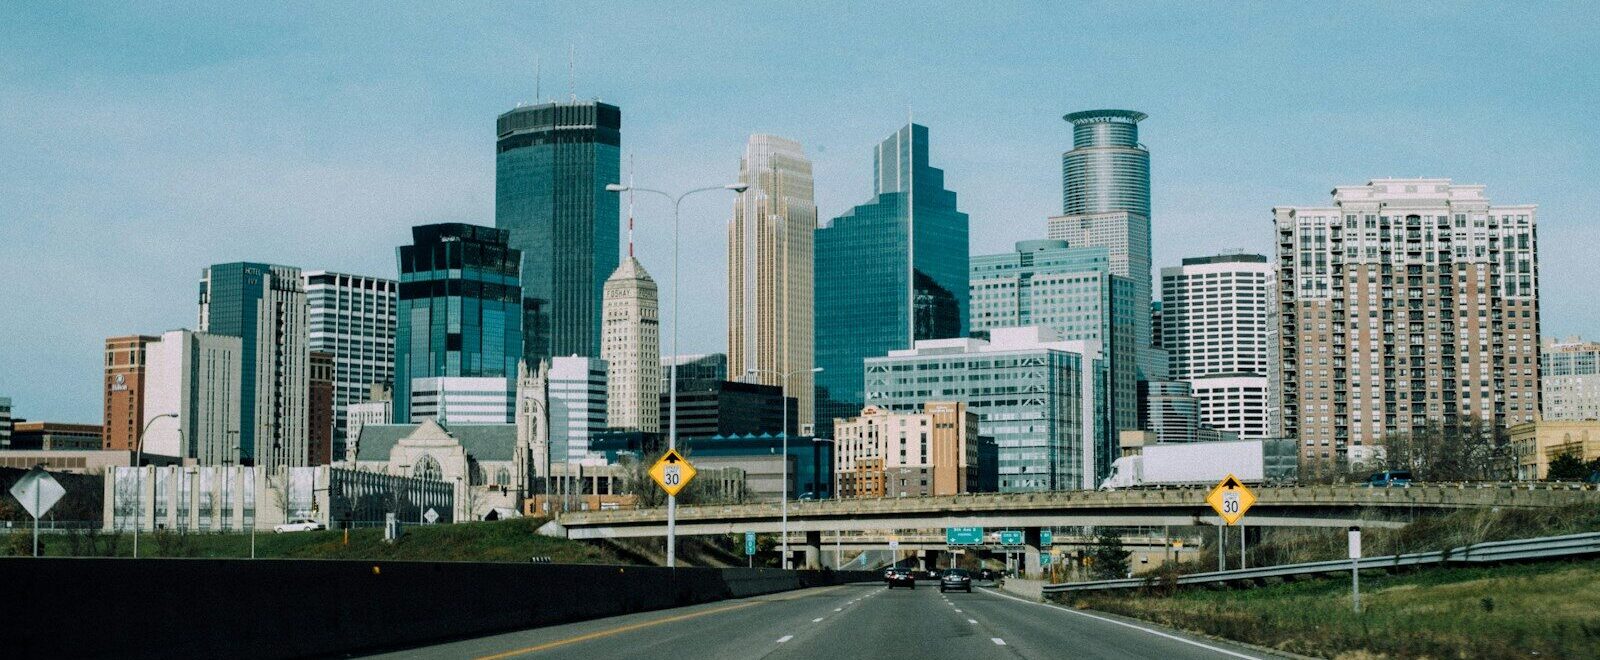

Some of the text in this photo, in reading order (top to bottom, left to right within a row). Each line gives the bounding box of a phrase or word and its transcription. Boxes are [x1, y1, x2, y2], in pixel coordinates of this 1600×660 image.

[245, 267, 261, 275] HOTEL
[665, 473, 679, 485] 30
[1224, 500, 1238, 513] 30
